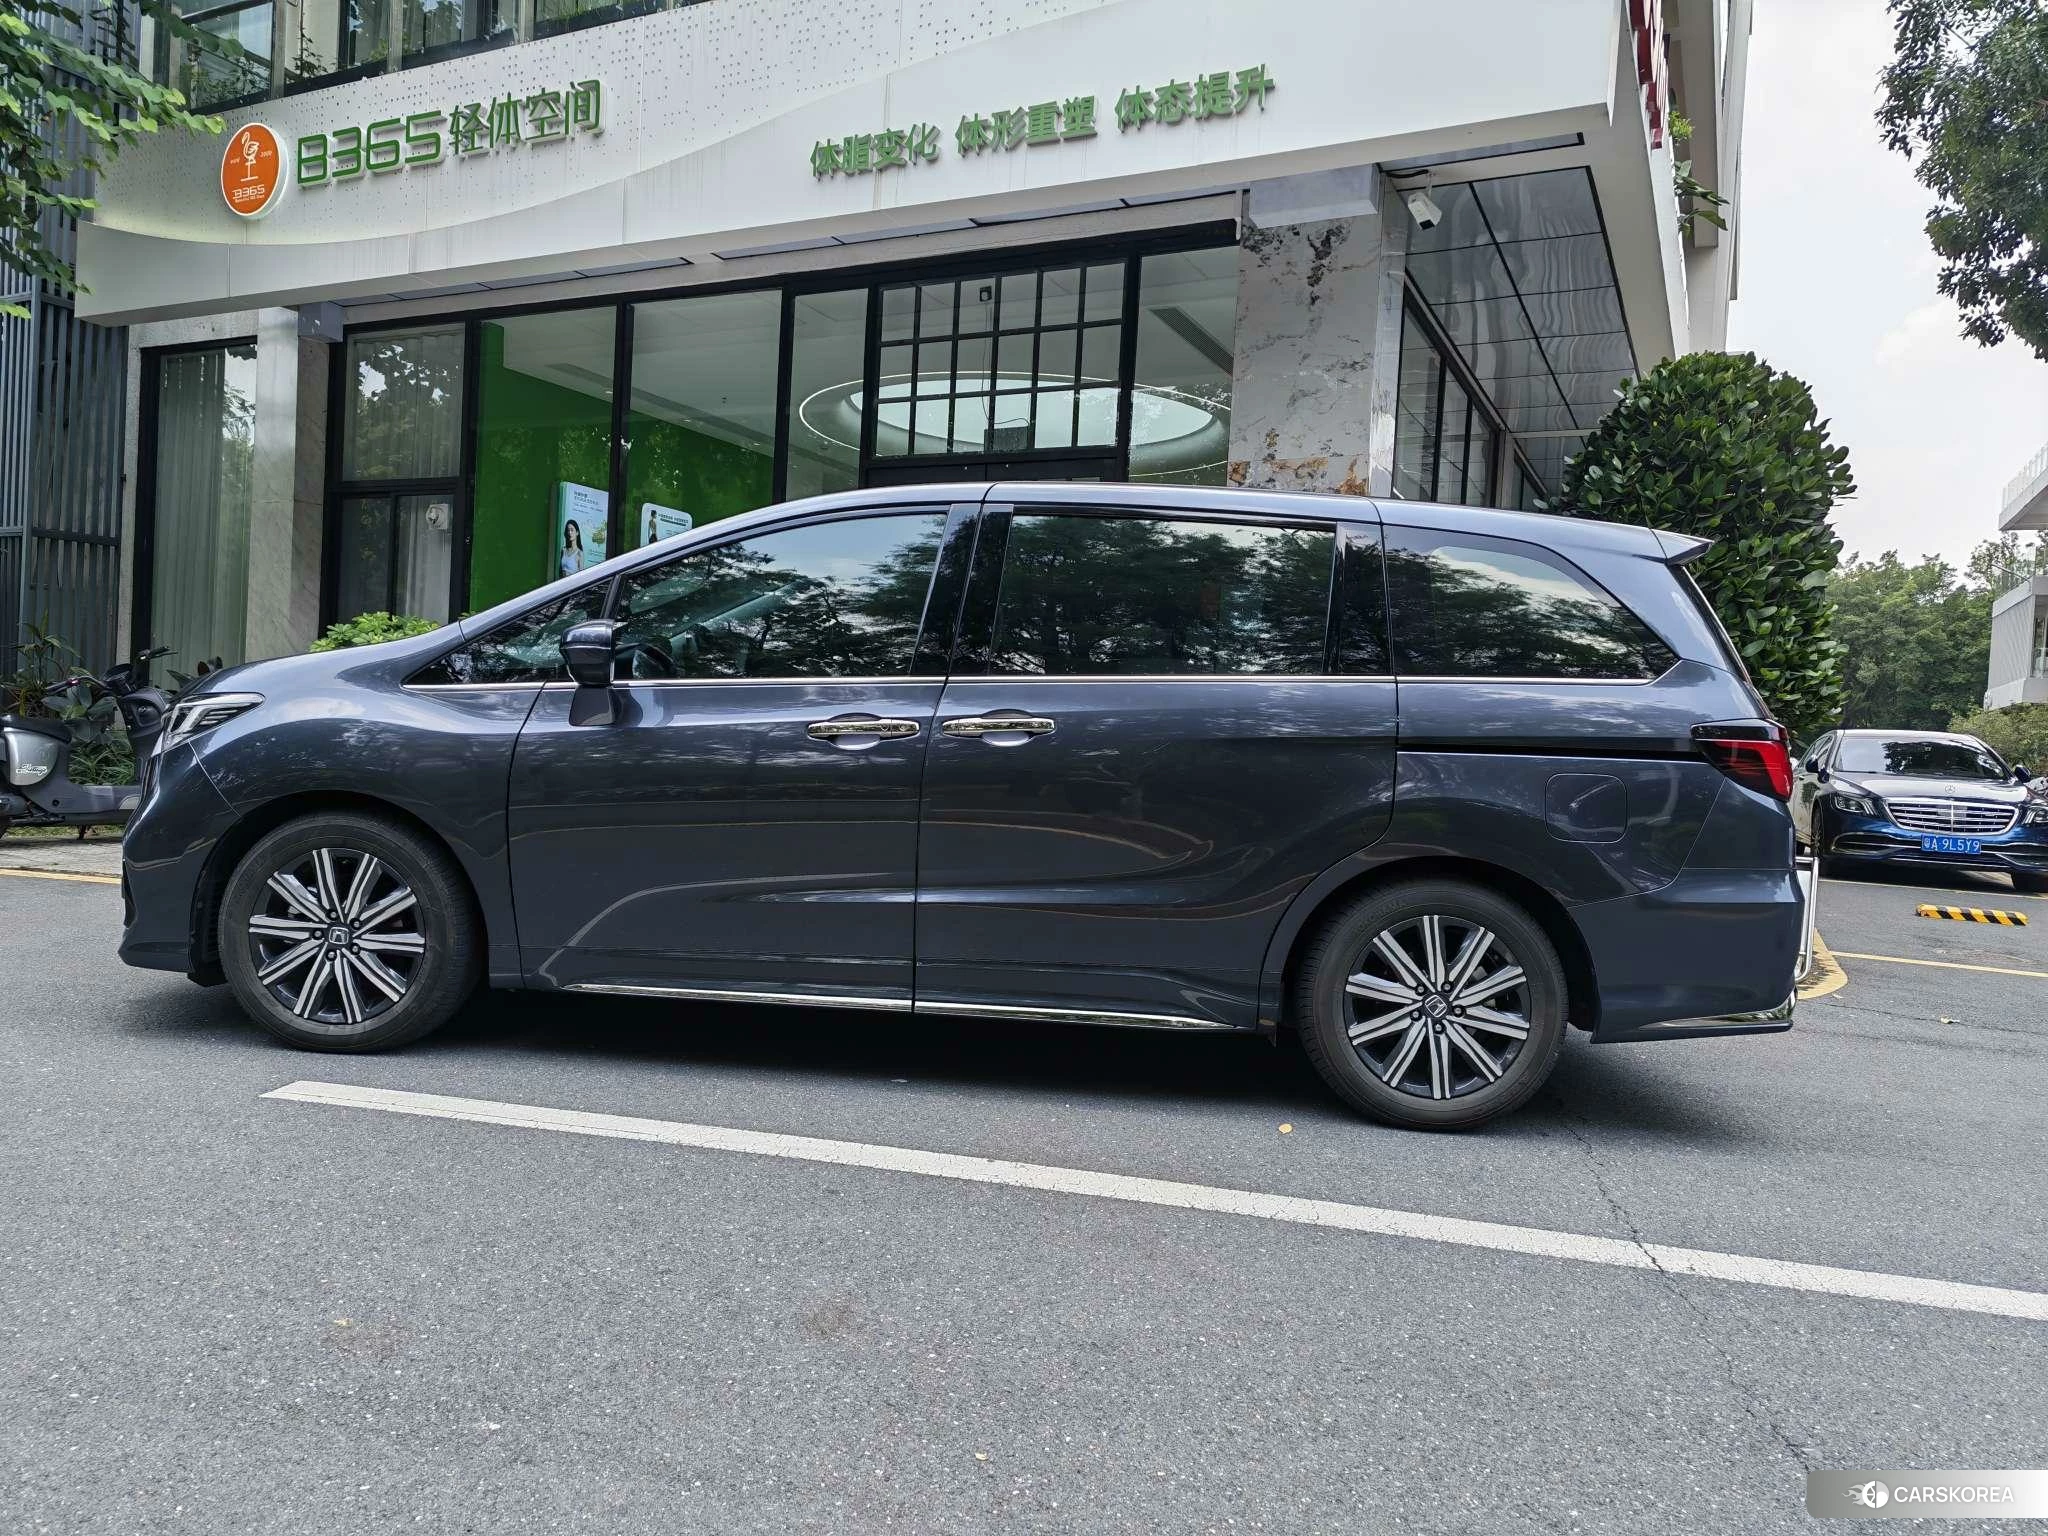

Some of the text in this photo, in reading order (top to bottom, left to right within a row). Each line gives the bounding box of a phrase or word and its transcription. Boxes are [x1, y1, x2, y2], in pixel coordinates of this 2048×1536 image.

[809, 64, 1275, 181] 体脂变化 体形重塑 体态提升
[232, 184, 265, 200] B365
